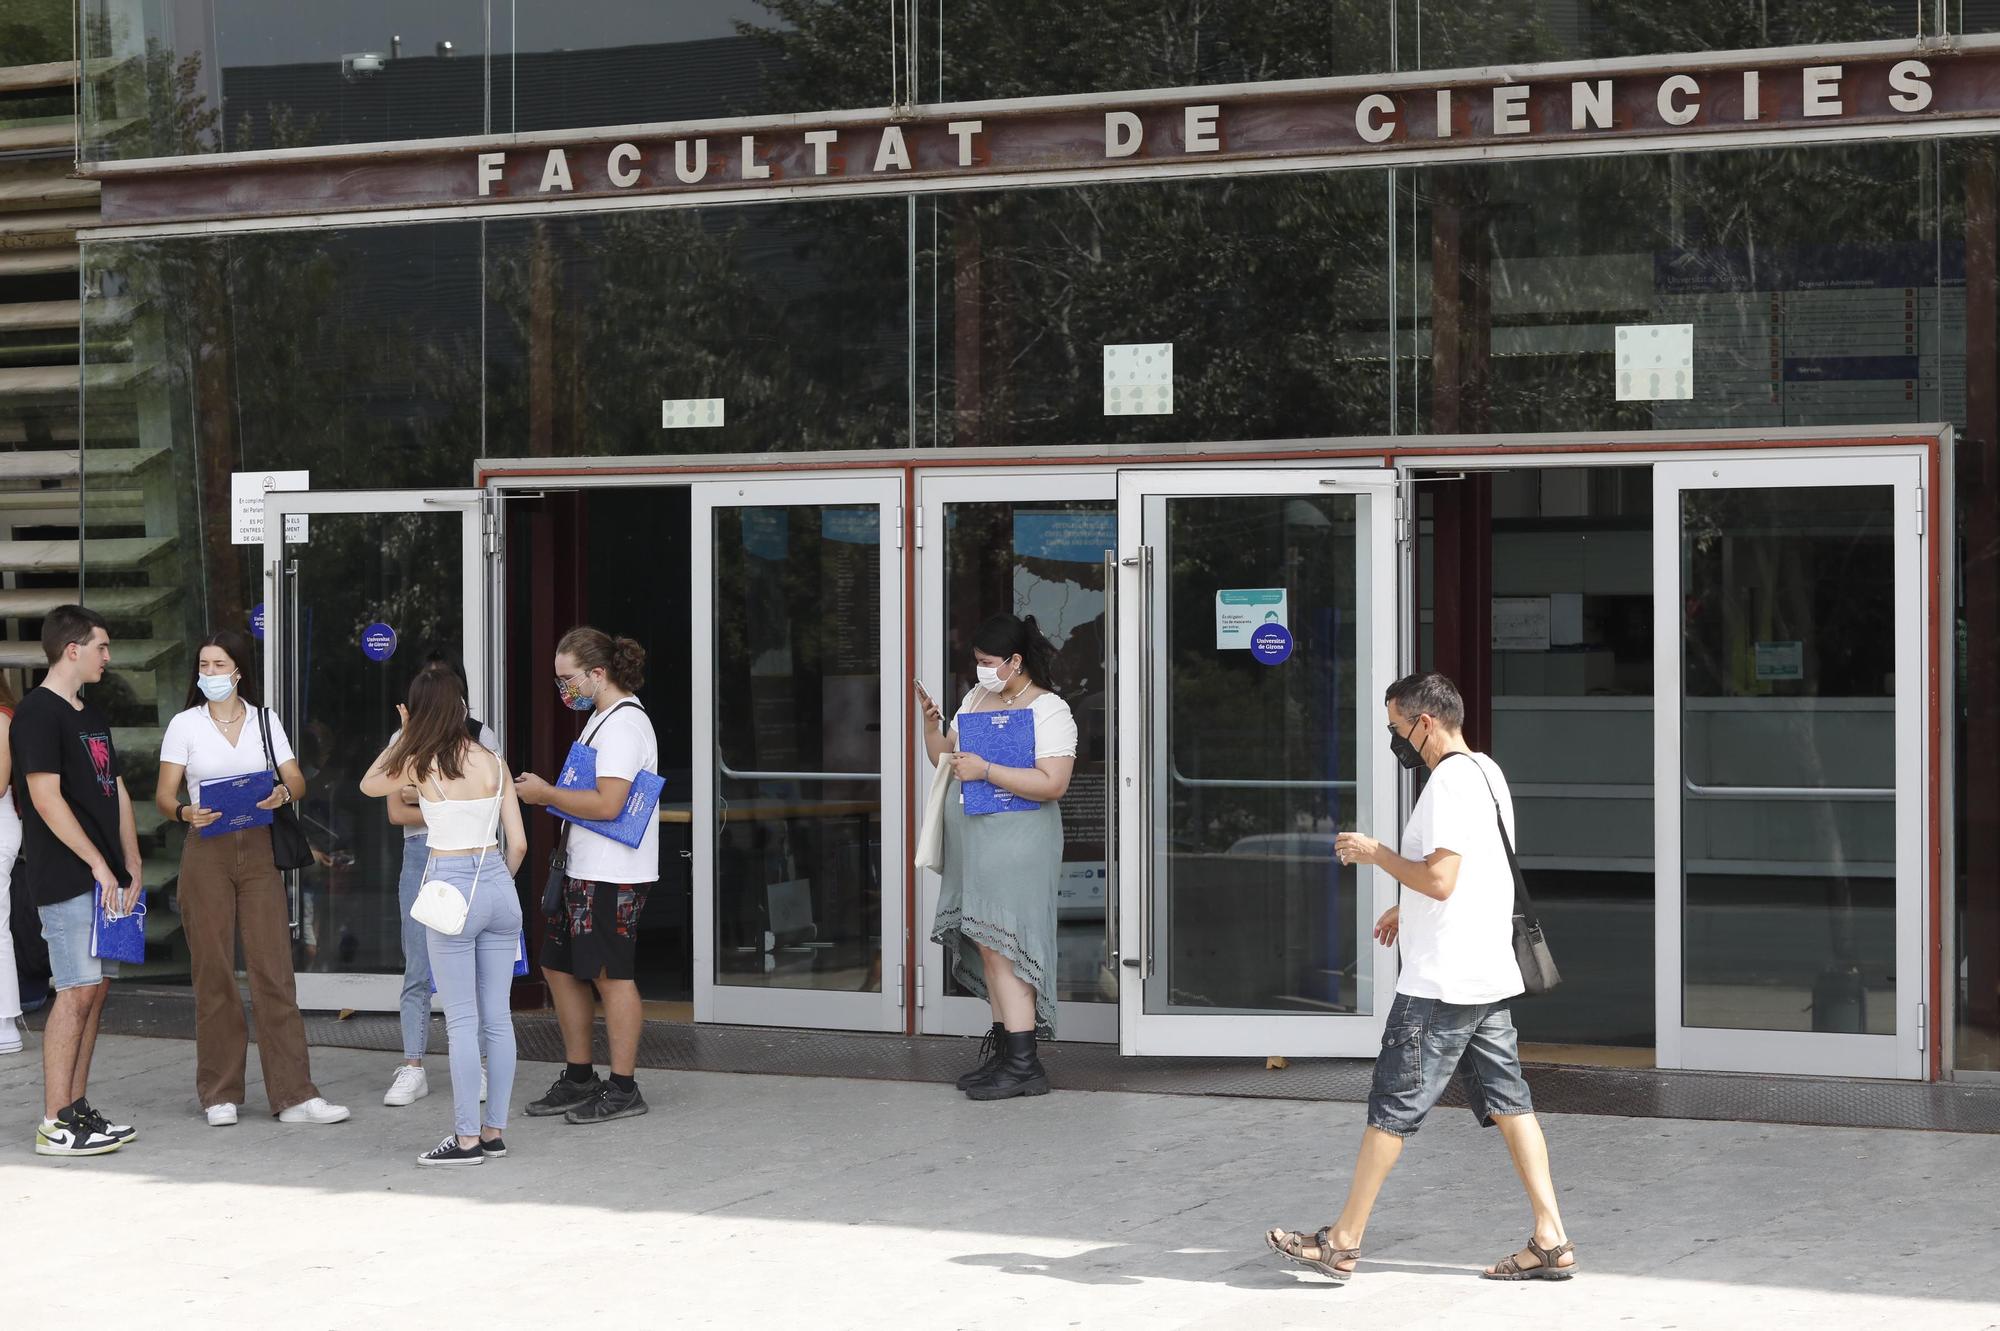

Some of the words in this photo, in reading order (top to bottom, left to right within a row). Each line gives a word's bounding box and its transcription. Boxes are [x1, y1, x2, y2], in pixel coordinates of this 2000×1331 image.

[478, 120, 982, 196] FACULTAT
[1105, 104, 1220, 158] DE
[1355, 59, 1933, 143] CIÈNCIES
